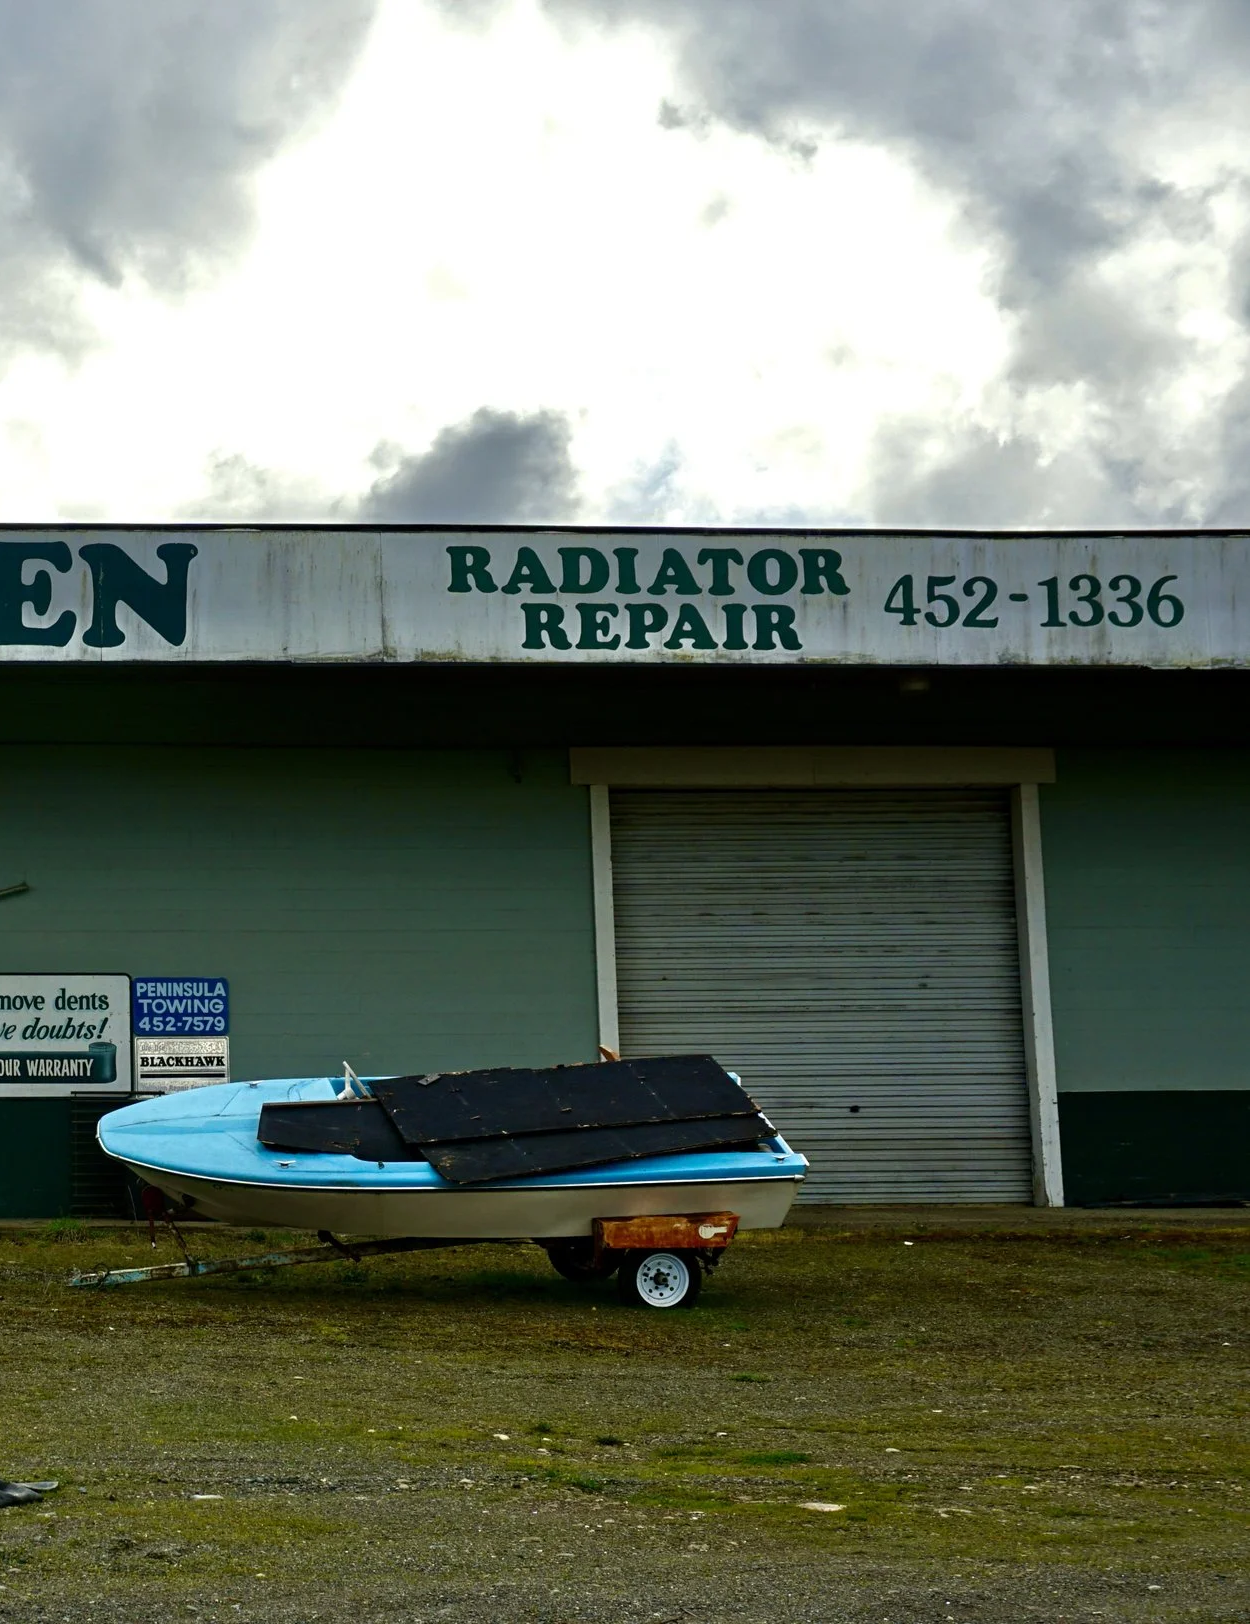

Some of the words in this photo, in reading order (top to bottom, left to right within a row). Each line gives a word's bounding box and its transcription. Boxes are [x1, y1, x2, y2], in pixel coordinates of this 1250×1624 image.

[445, 545, 851, 597] RADIATOR
[883, 574, 1185, 628] 452-1336
[519, 602, 803, 651] REPAIR
[54, 987, 110, 1011] dents
[136, 982, 226, 997] PENINSULA
[138, 998, 225, 1014] TOWING
[21, 1017, 109, 1040] doubts!
[138, 1016, 226, 1032] 452-7579
[27, 1058, 94, 1077] WARRANTY
[139, 1055, 226, 1067] BLACKHAWK
